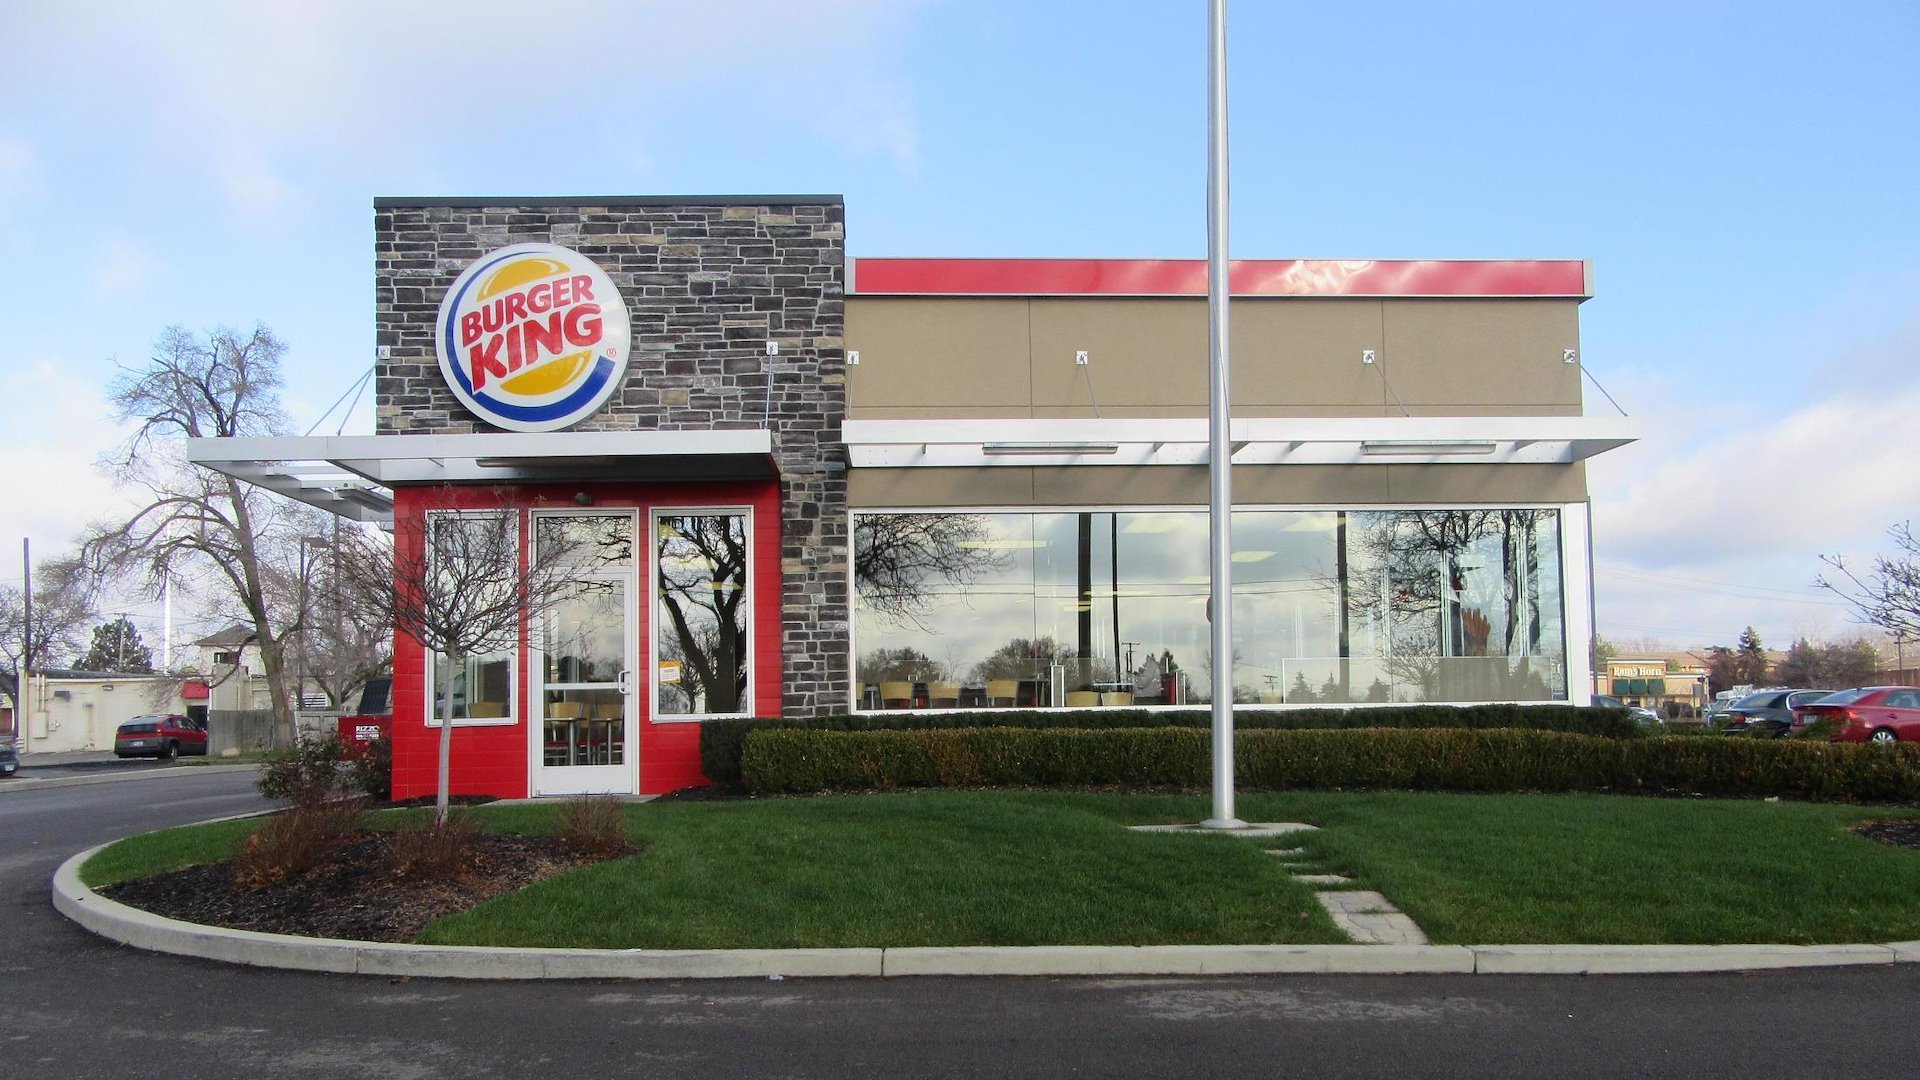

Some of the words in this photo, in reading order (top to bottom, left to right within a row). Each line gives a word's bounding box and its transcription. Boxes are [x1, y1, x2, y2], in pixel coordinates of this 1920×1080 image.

[461, 274, 595, 348] BURGER
[469, 303, 603, 392] KING
[1613, 666, 1638, 676] Ram's
[1639, 666, 1662, 676] Horn
